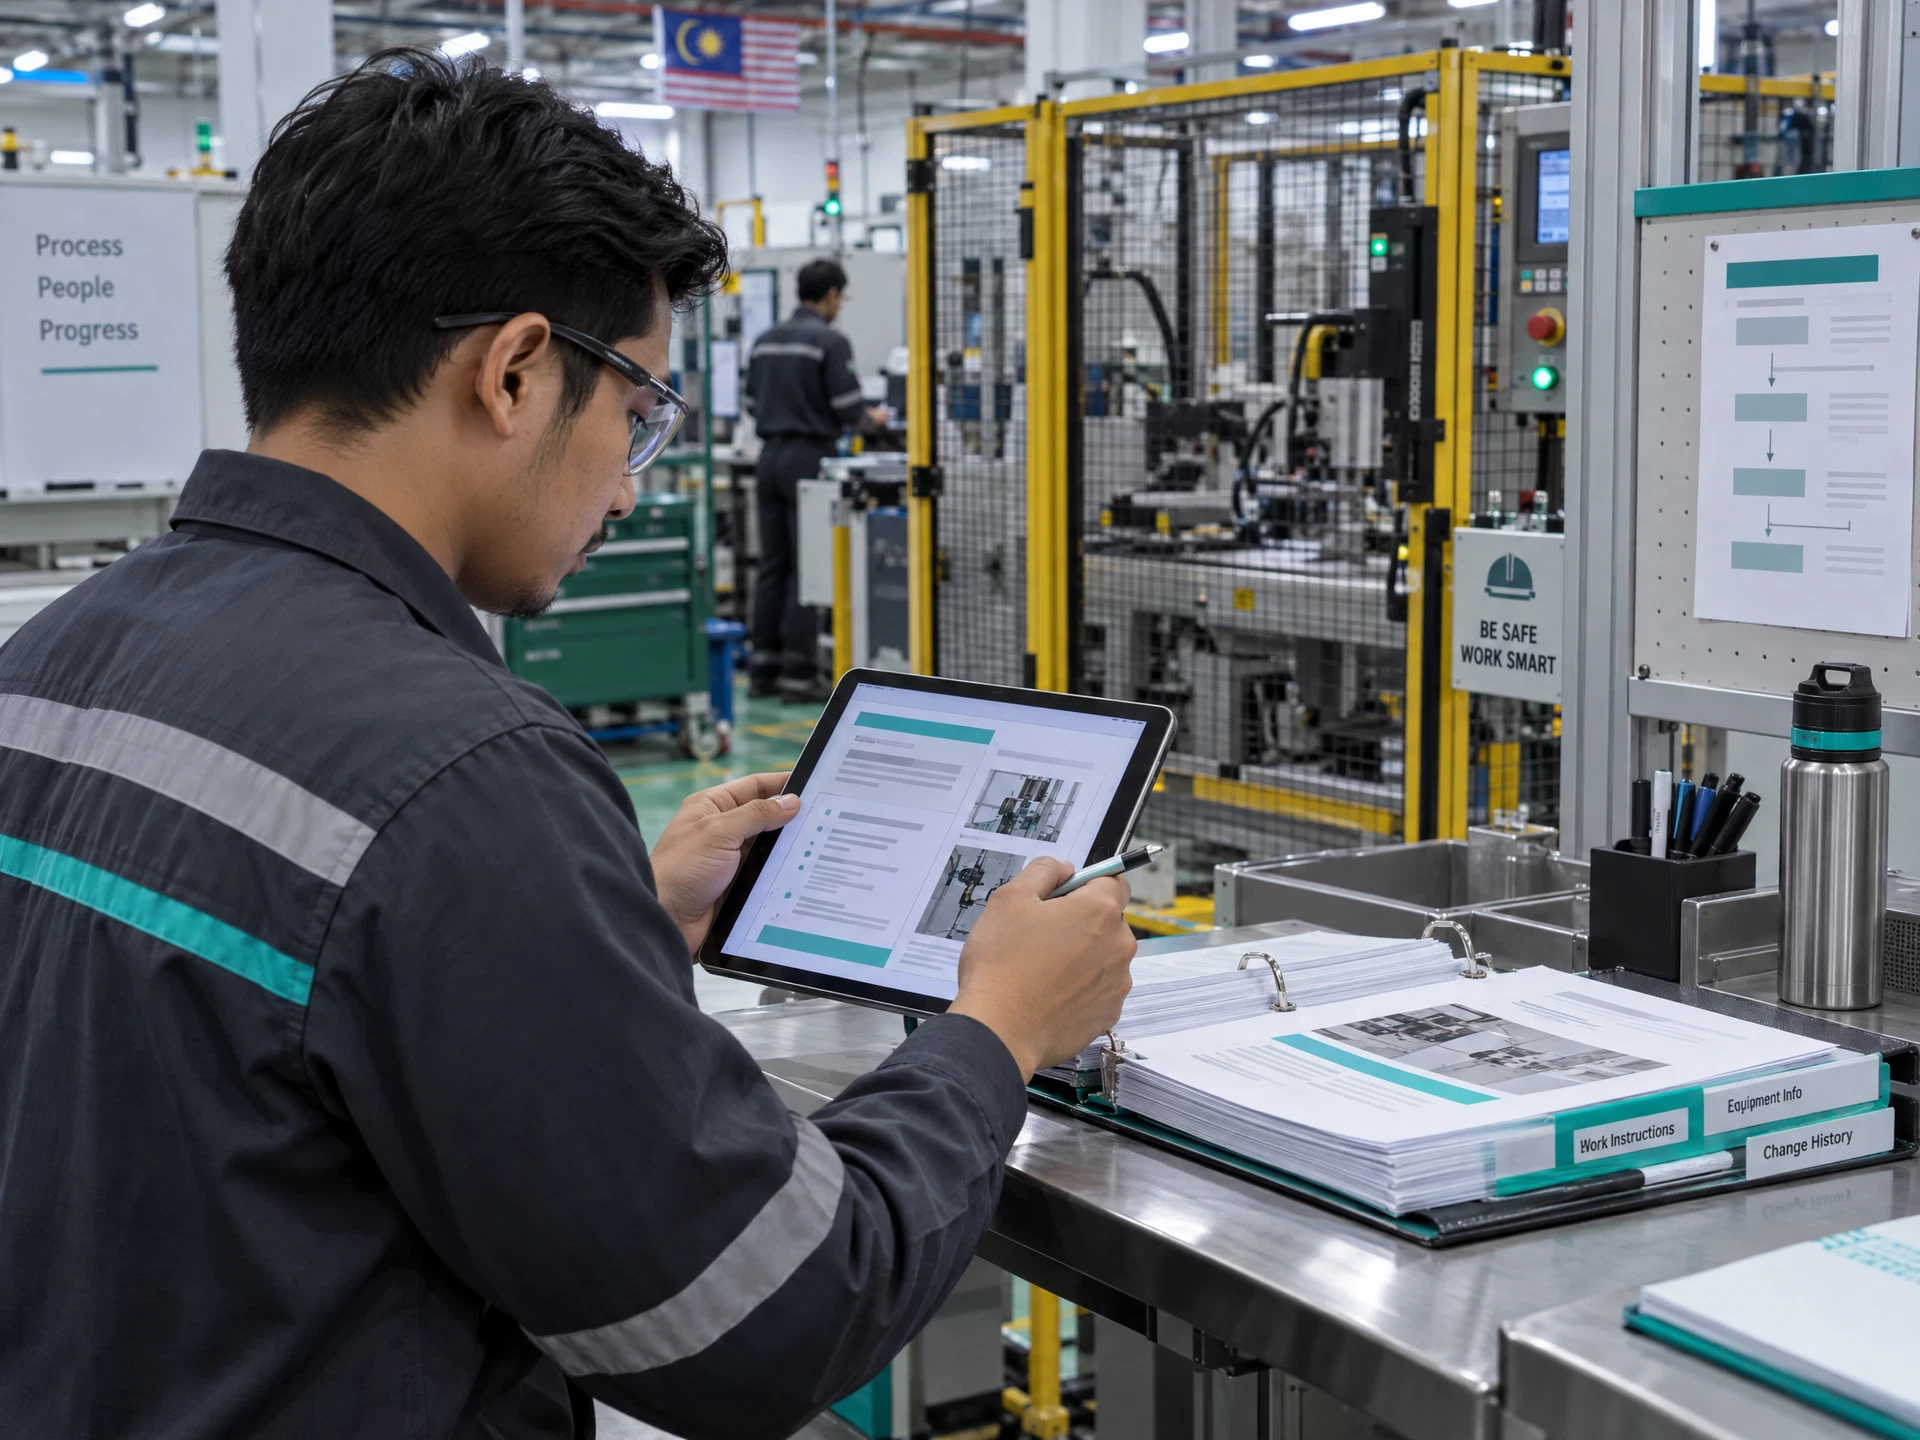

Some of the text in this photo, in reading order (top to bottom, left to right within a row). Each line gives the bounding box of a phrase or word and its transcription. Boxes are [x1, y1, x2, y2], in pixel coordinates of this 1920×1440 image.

[35, 233, 123, 257] Process
[37, 275, 115, 303] People
[39, 318, 139, 346] Progress
[1480, 619, 1538, 645] BE SAFE
[1461, 644, 1556, 675] WORK SMART
[1783, 1085, 1803, 1102] Info
[1580, 1123, 1675, 1154] Work Instructions
[1763, 1130, 1853, 1160] Change History
